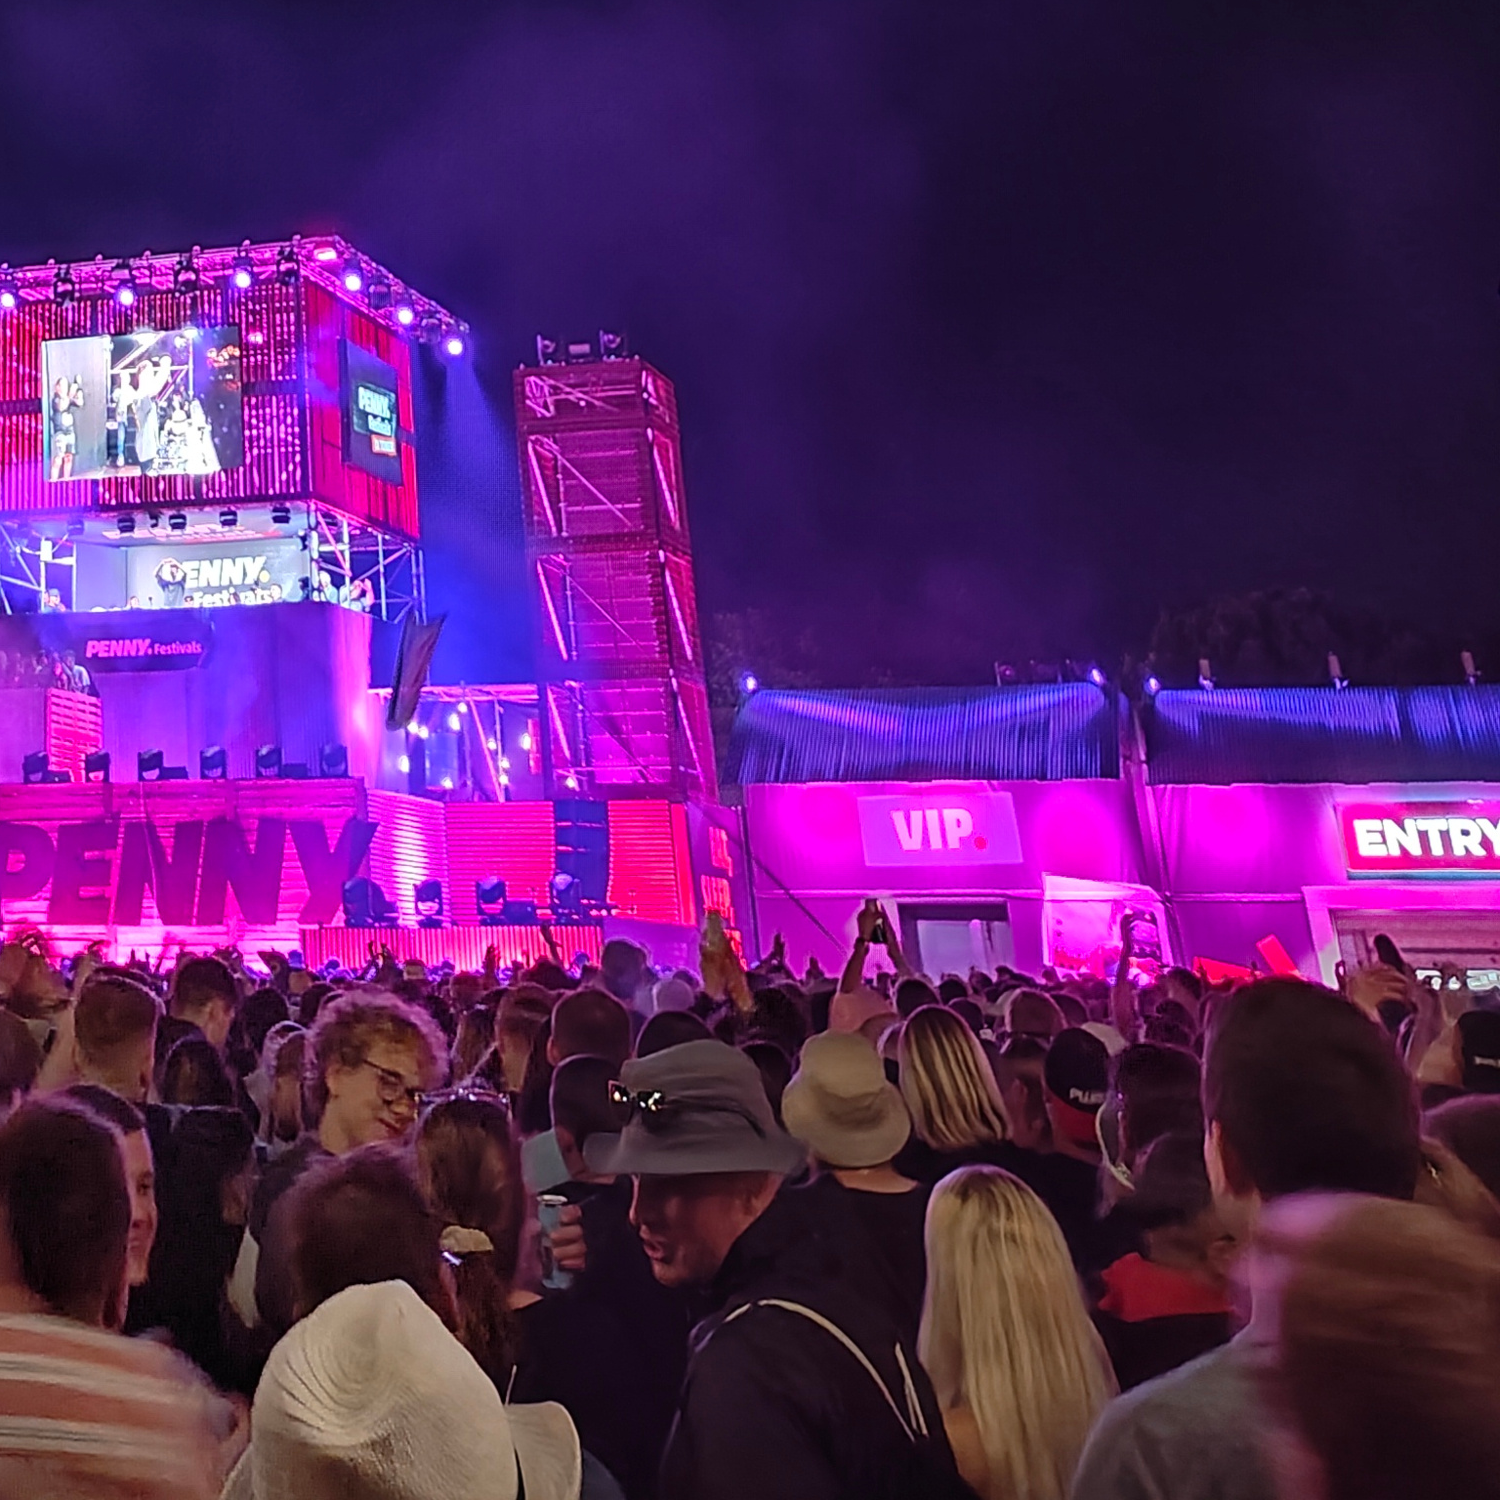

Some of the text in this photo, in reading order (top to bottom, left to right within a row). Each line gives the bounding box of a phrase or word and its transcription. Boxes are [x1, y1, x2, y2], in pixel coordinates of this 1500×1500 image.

[180, 556, 270, 588] ENNY.
[86, 639, 202, 658] PENNY. Festivals
